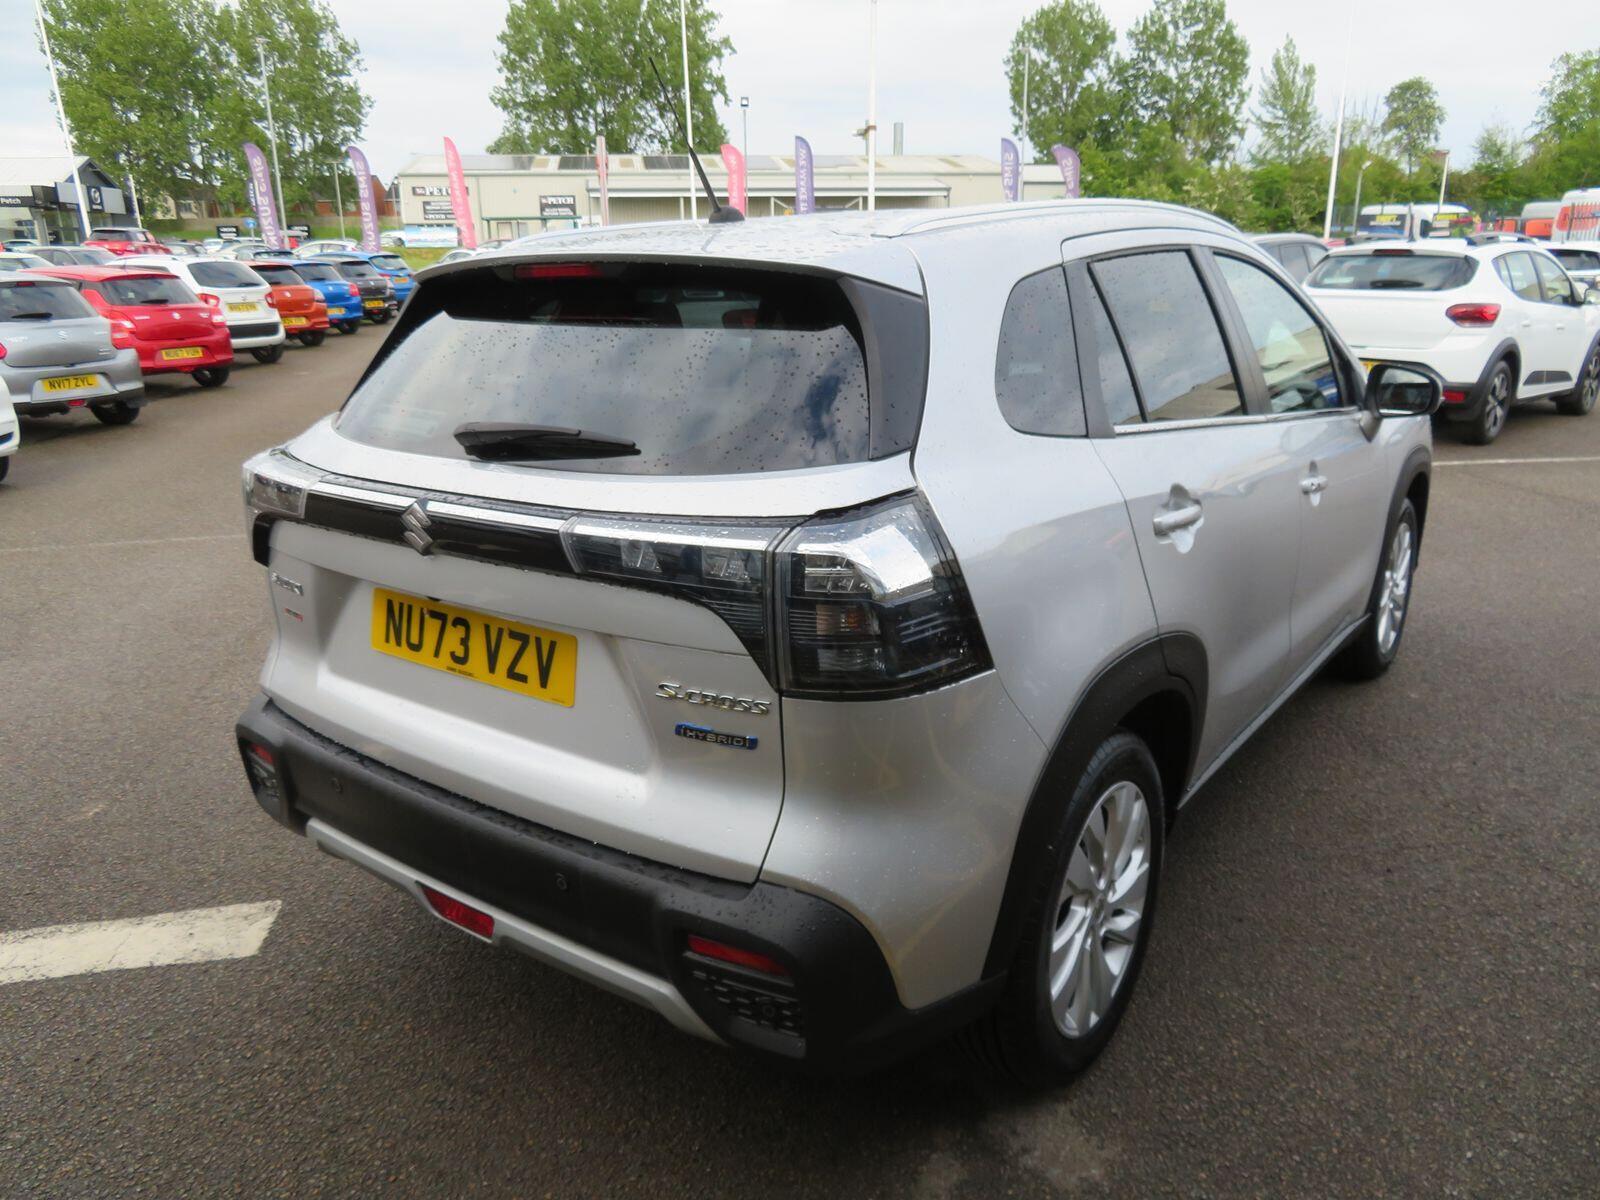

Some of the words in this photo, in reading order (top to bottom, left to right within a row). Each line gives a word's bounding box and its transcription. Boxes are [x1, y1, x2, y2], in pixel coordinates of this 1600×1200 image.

[48, 379, 71, 390] NV17
[74, 376, 93, 387] ZYL
[385, 598, 471, 666] NU73
[484, 623, 557, 690] VZV
[685, 729, 744, 748] HYBRID
